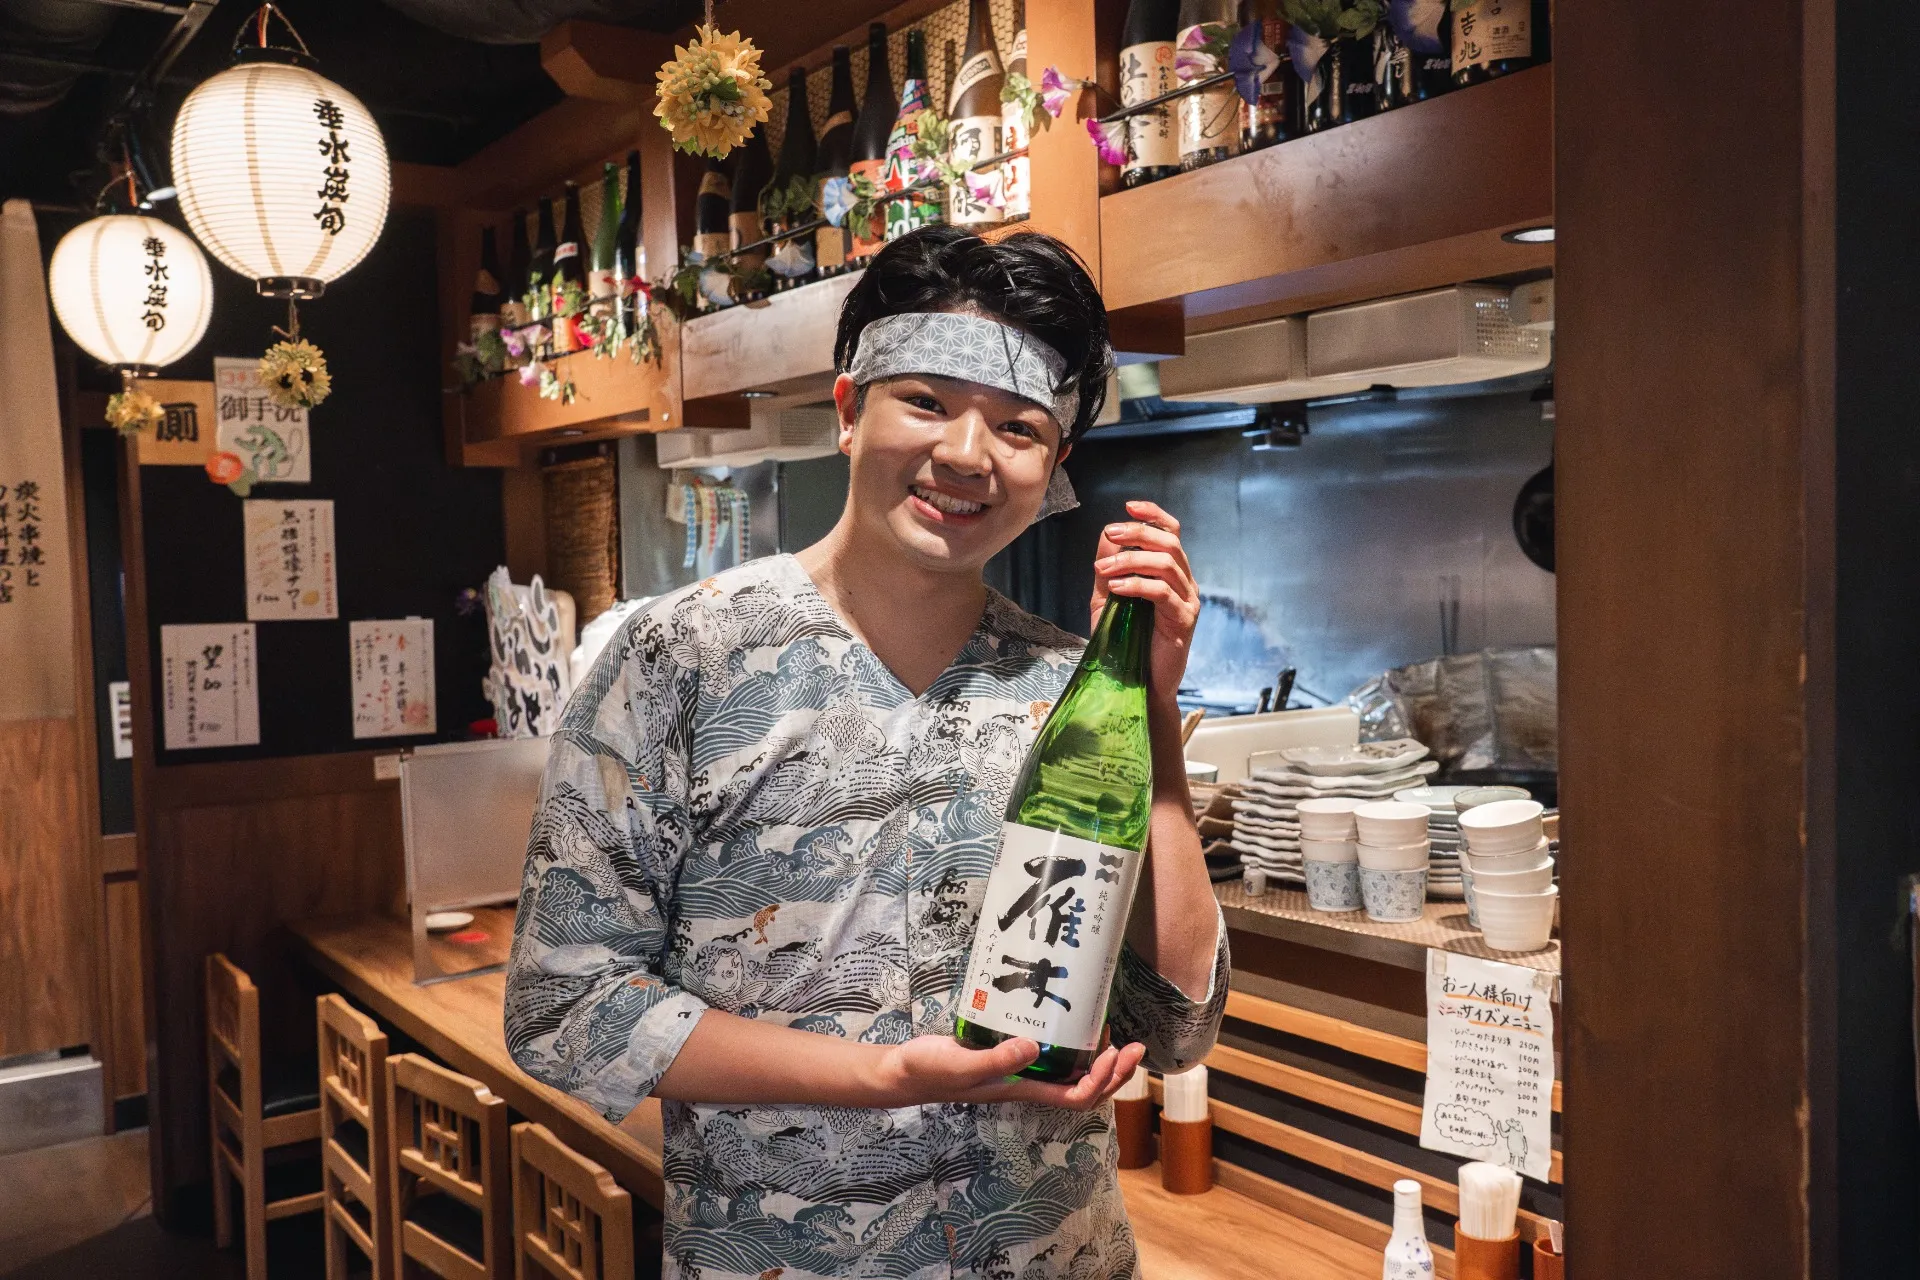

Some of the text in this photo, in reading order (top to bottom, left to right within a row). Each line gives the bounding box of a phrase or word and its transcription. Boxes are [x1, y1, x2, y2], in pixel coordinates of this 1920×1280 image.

[1090, 889, 1109, 936] 純米吟醸
[1442, 976, 1532, 1012] お一人様向け
[1005, 1012, 1047, 1029] GANGI
